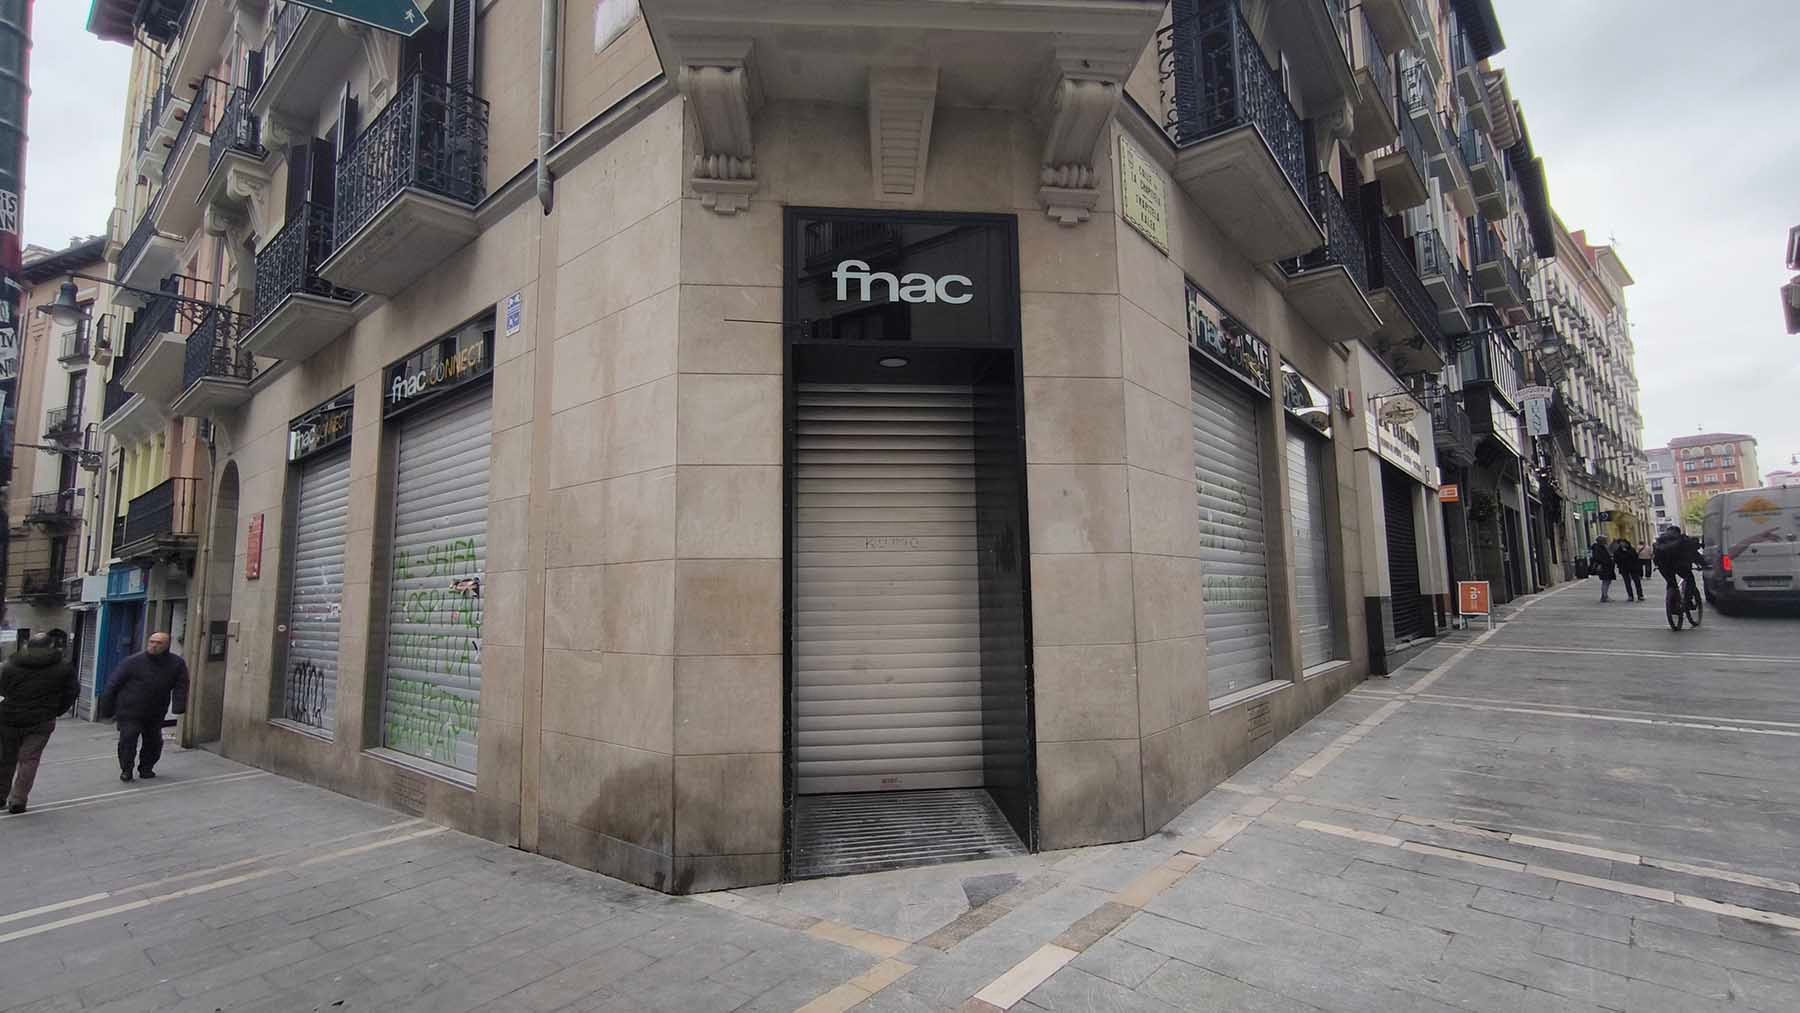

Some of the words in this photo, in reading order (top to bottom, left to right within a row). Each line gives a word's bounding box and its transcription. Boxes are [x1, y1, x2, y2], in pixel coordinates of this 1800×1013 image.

[832, 259, 973, 304] fnac
[391, 369, 427, 404] fnac
[429, 340, 484, 382] CONNECT
